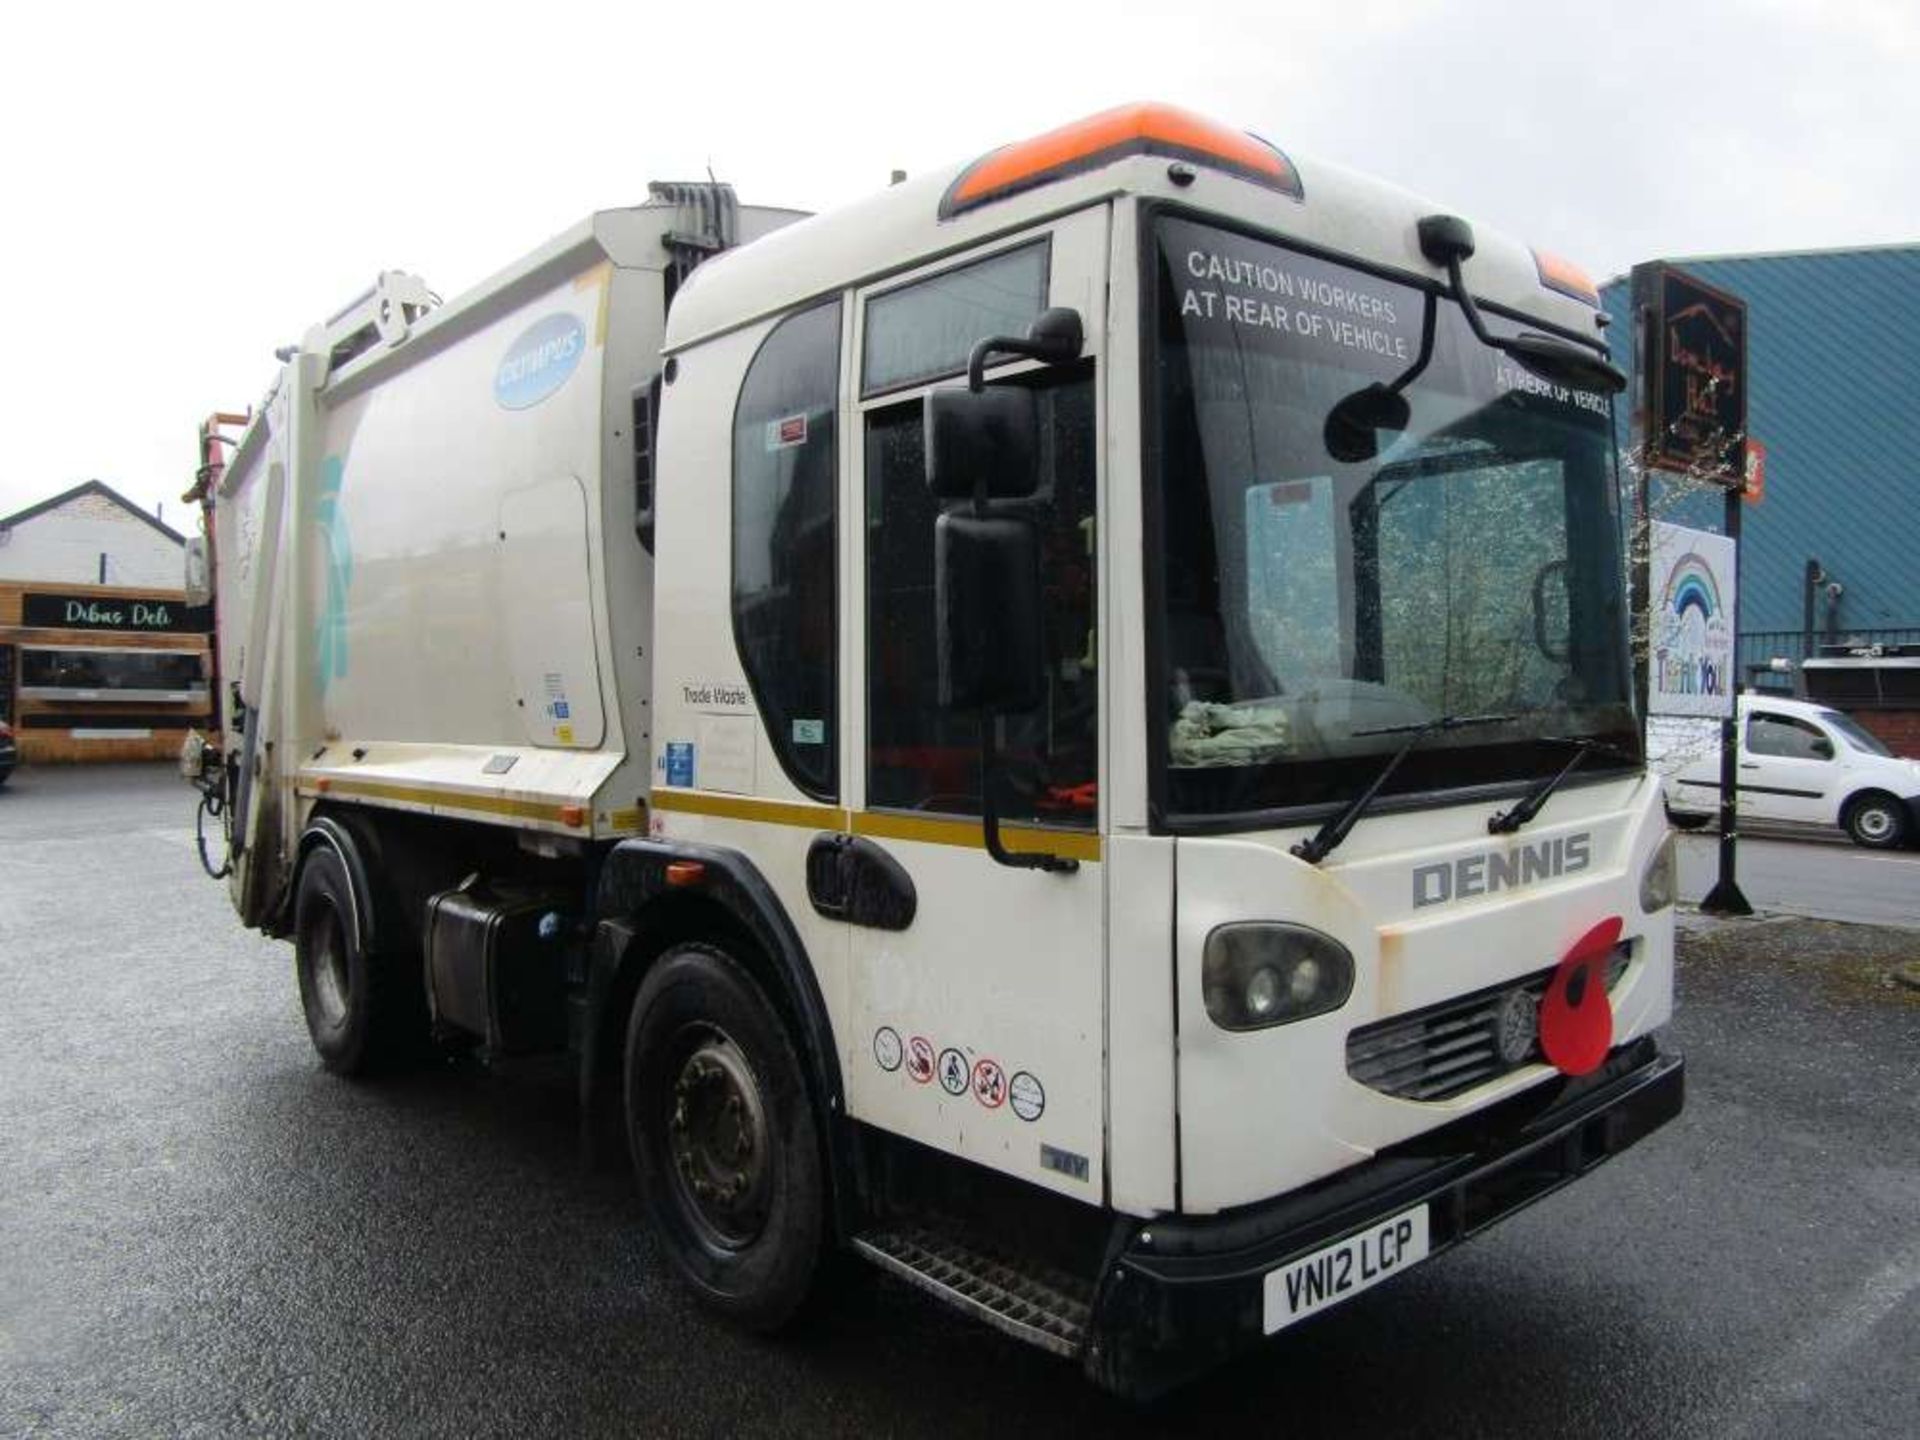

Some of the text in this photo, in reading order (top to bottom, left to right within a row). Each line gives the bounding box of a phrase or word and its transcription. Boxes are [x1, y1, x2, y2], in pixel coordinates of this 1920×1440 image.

[1188, 251, 1397, 324] CAUTION WORKERS
[1182, 289, 1408, 359] AT REAR OF VEHICLE
[132, 604, 171, 626] Deli
[683, 687, 746, 705] Trade Waste
[1413, 832, 1590, 909] DENNIS
[1286, 1218, 1412, 1313] VN12 LCP
